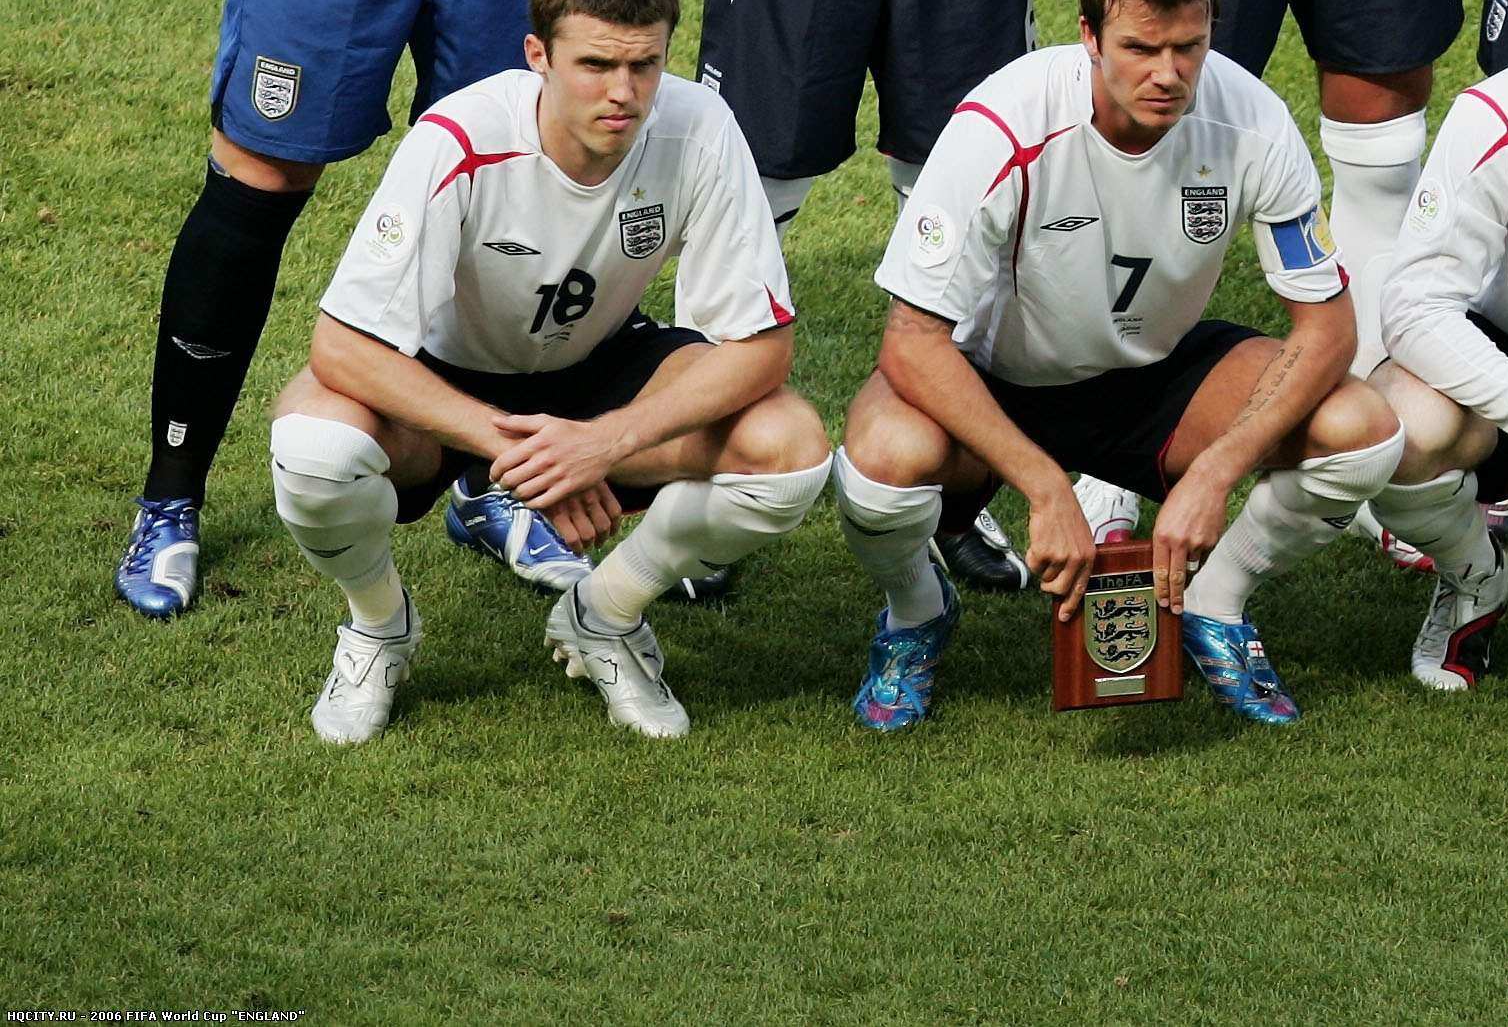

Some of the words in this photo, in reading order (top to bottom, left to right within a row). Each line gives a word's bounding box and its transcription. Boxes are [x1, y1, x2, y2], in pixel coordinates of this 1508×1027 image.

[1184, 187, 1225, 196] ENGLAND
[621, 206, 661, 221] ENGLAND
[529, 268, 597, 334] 18
[1111, 254, 1153, 313] 7
